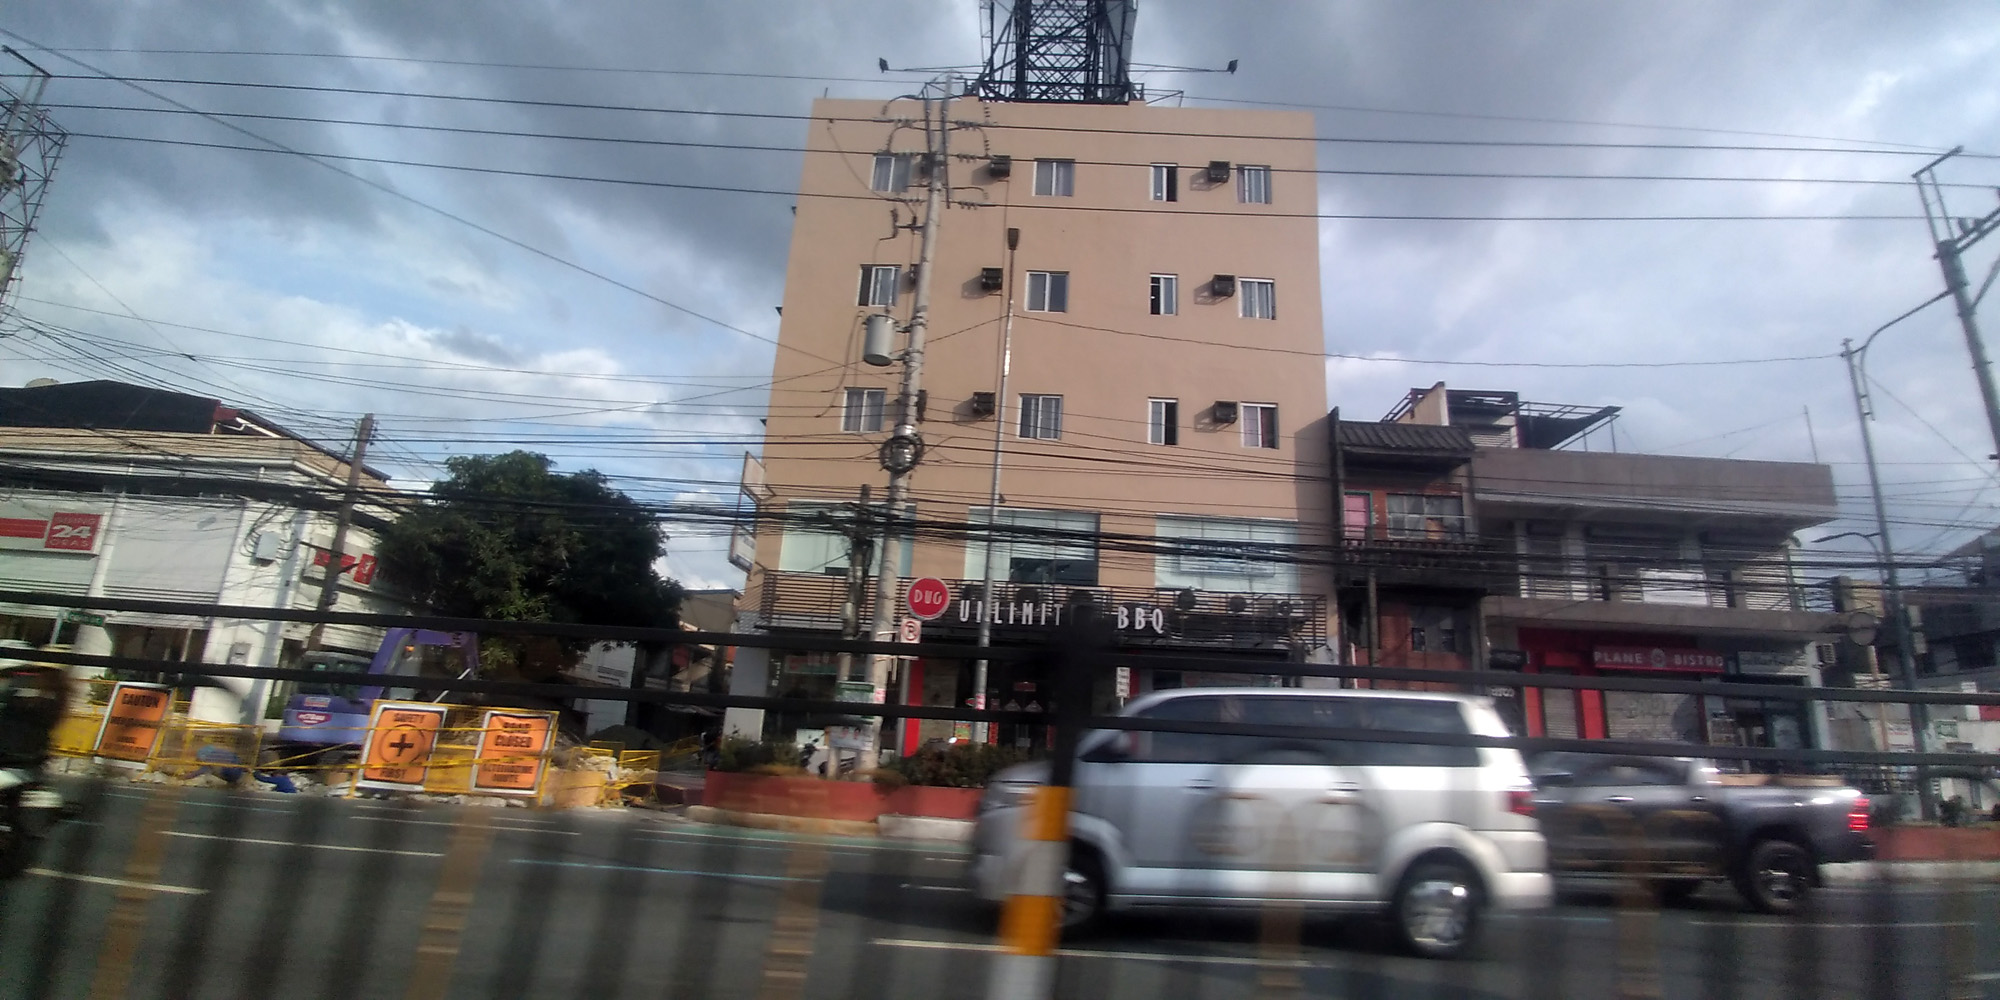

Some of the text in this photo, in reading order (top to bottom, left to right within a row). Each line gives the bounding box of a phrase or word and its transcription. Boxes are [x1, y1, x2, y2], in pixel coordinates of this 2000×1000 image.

[51, 524, 92, 539] 24
[1117, 606, 1165, 634] BBQ
[1594, 651, 1643, 664] PLANE
[1673, 653, 1725, 667] BISTRO
